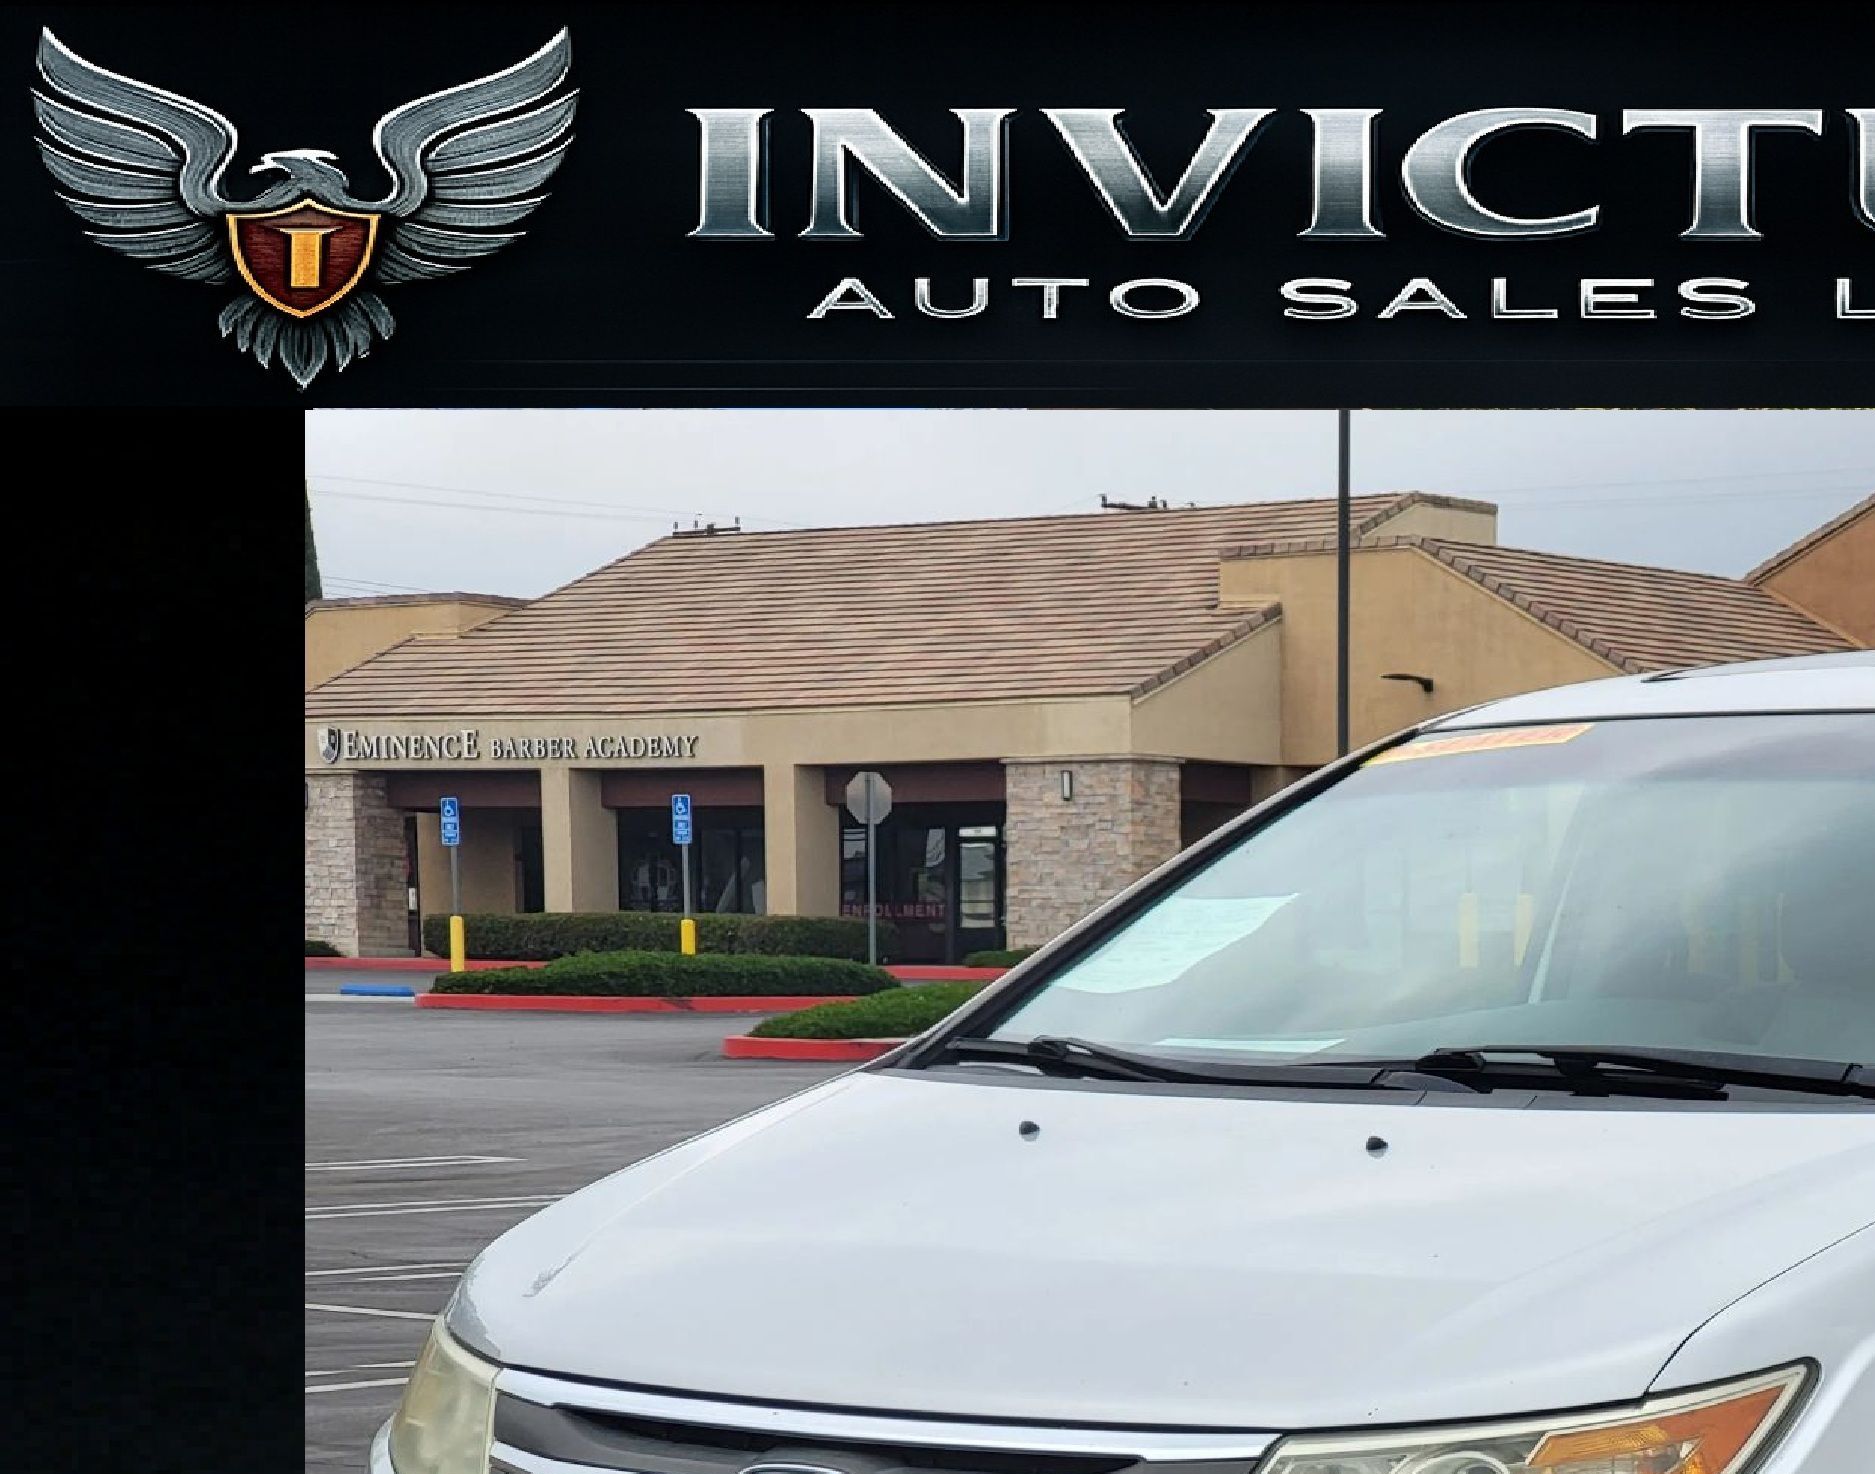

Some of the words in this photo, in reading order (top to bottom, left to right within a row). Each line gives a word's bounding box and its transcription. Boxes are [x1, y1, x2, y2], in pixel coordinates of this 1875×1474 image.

[342, 729, 480, 760] EMINENCE
[490, 734, 579, 760] BARBER
[584, 734, 699, 760] ACADEMY
